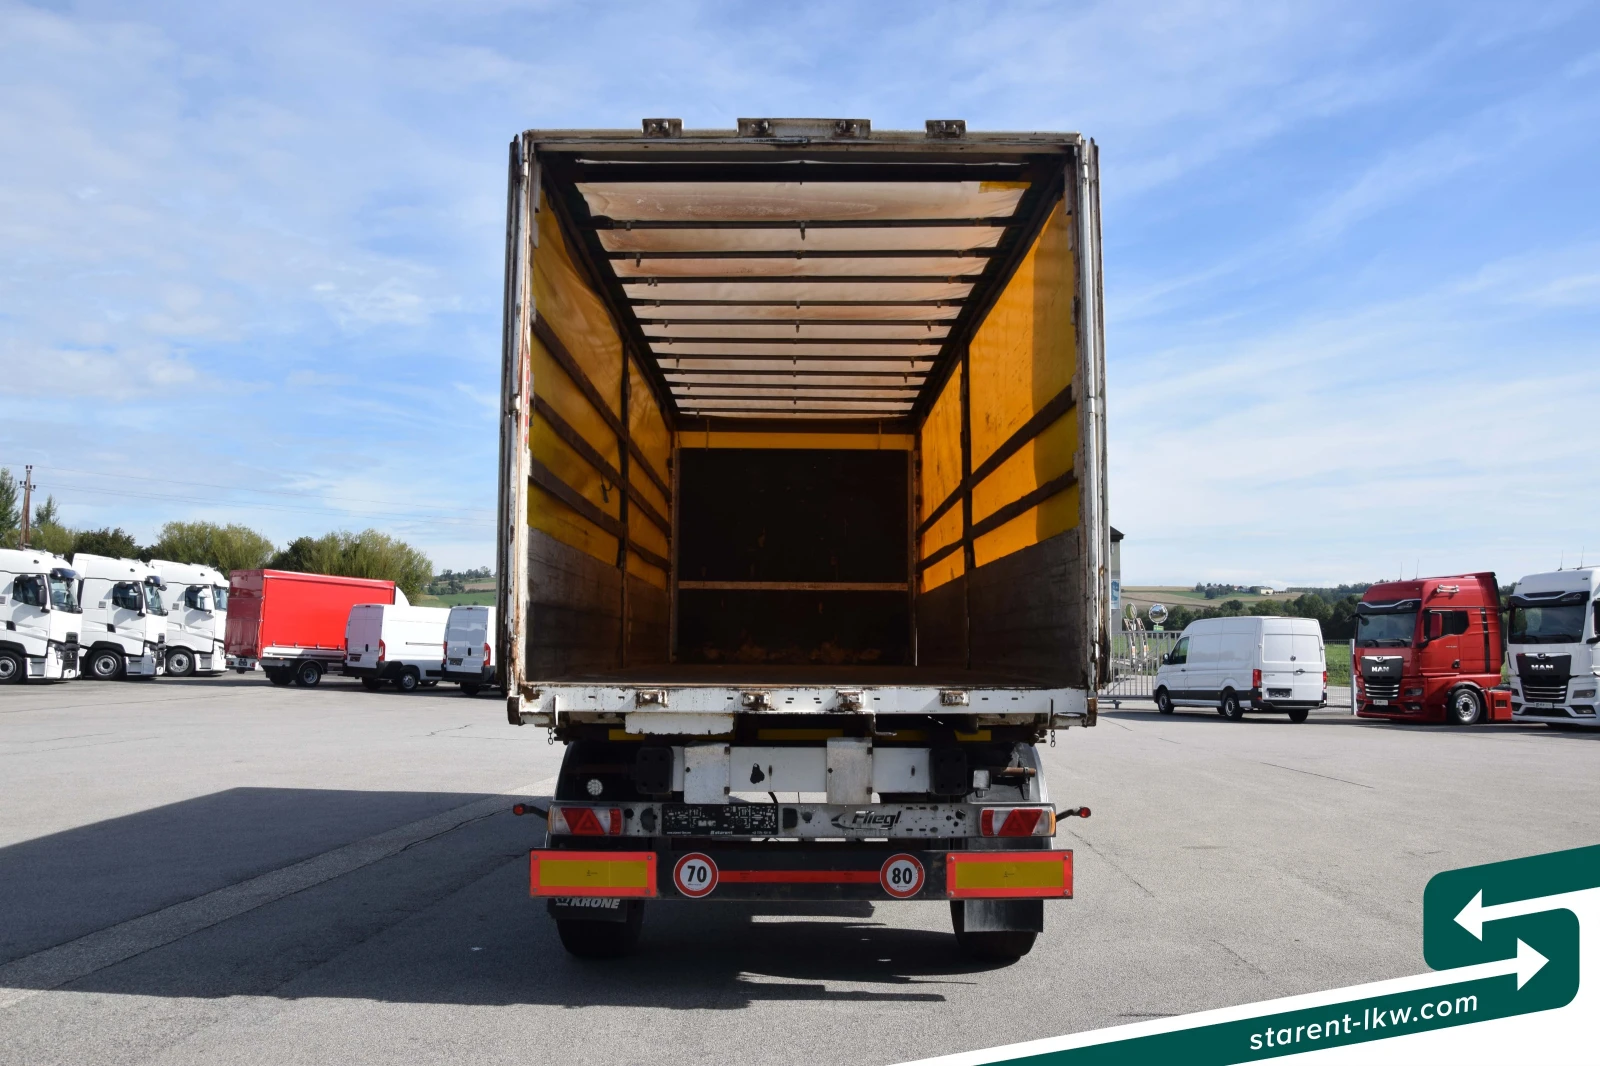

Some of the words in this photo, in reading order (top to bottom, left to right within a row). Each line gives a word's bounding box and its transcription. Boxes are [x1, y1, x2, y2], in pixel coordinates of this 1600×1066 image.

[852, 810, 902, 828] Fliegl
[687, 865, 707, 883] 70
[892, 867, 913, 885] 80
[570, 897, 621, 909] KRONE
